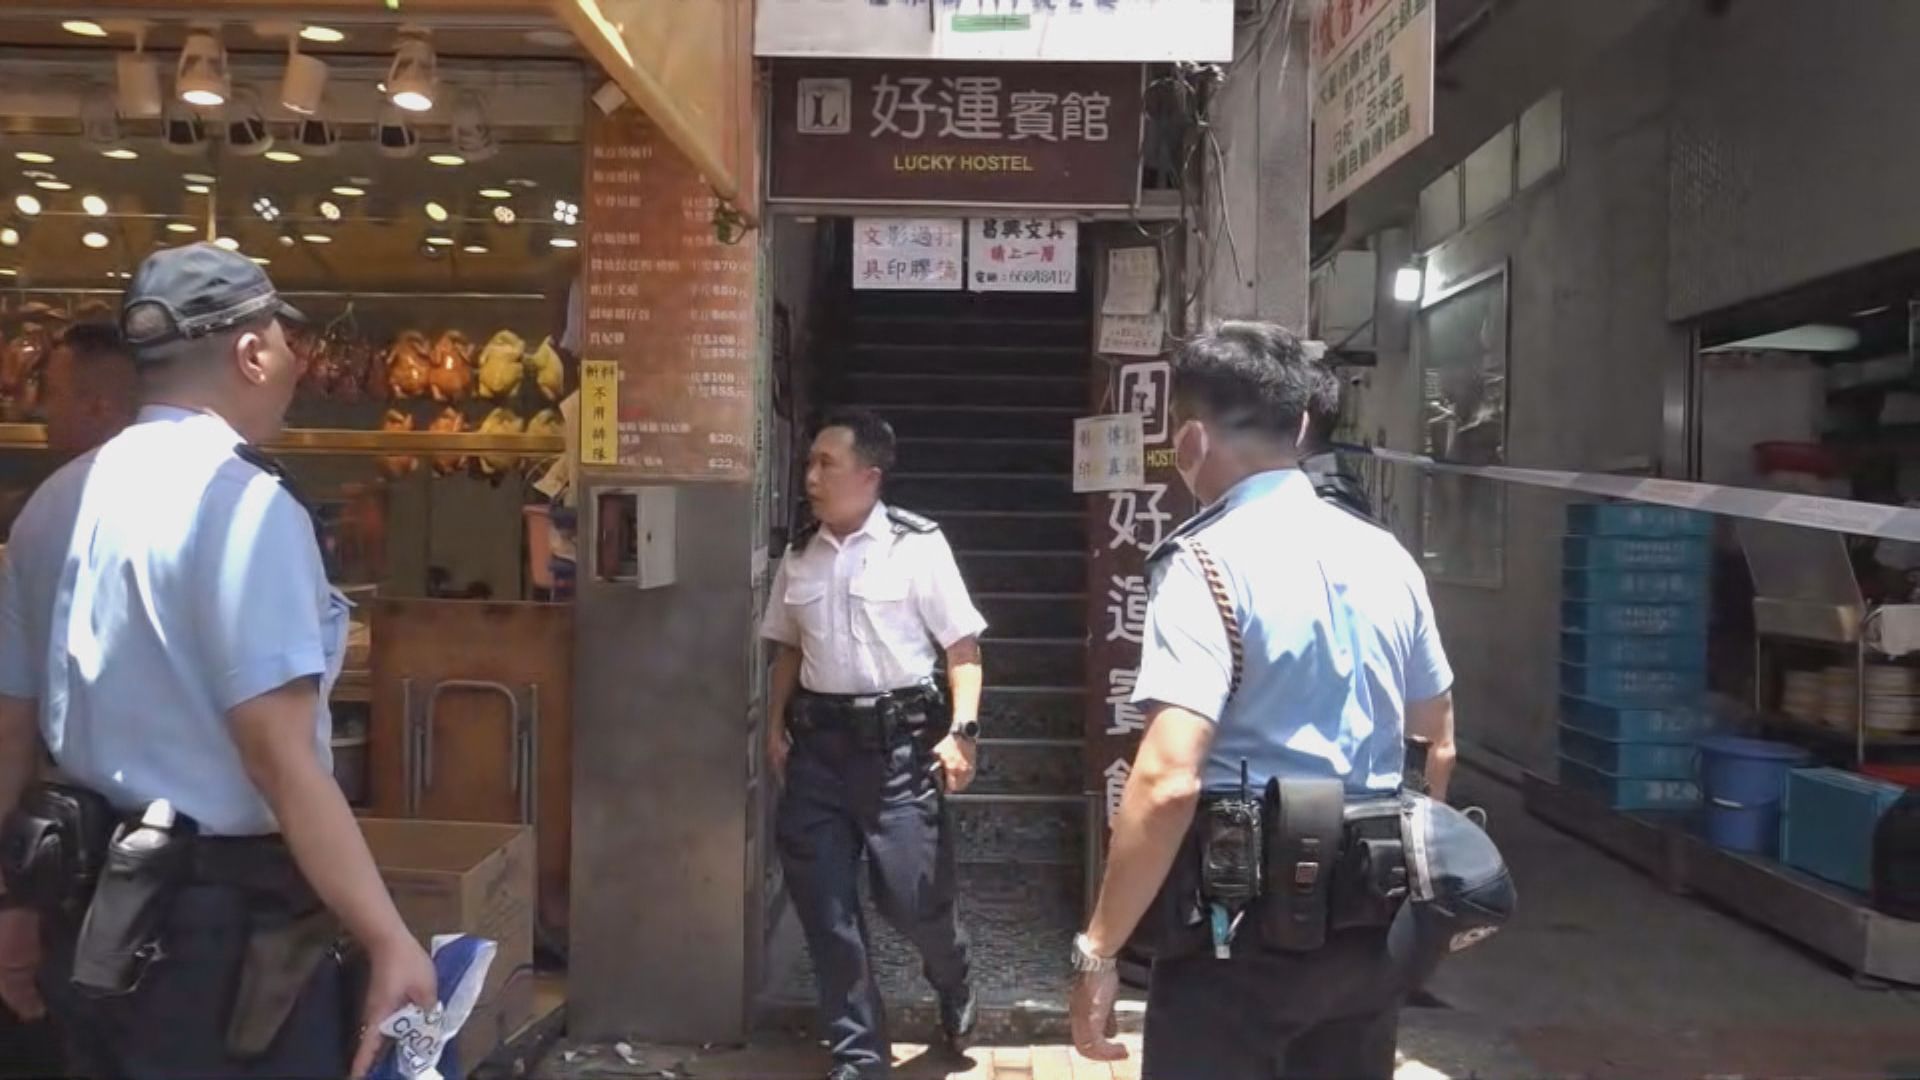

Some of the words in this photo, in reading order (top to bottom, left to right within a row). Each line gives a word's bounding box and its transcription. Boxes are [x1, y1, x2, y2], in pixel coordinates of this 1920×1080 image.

[870, 73, 1110, 143] 好運賓館
[894, 155, 957, 171] LUCKY
[961, 156, 1033, 172] HOSTEL
